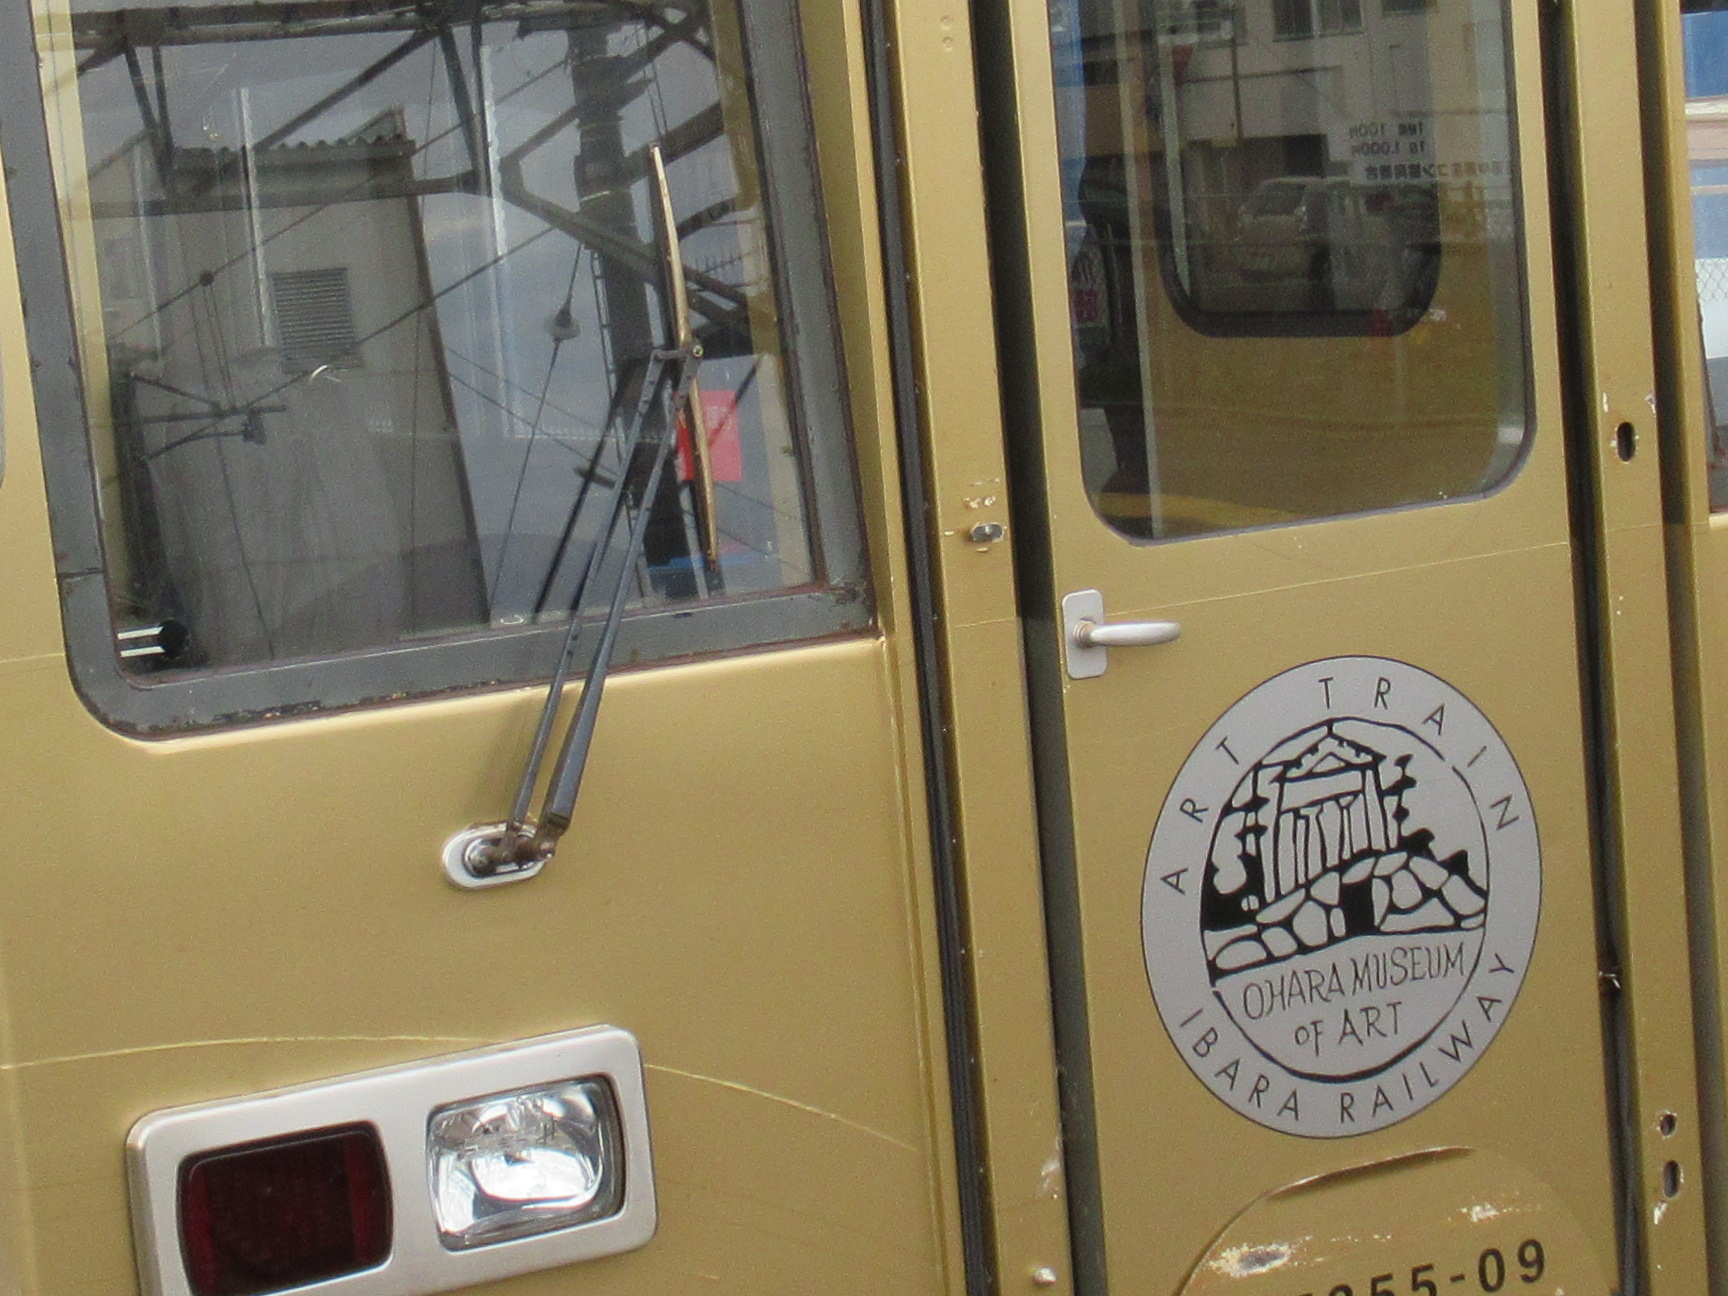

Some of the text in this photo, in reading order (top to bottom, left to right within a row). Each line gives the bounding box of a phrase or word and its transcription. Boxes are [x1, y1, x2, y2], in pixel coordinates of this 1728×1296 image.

[1160, 676, 1520, 895] ART TRAIN
[1178, 952, 1515, 1124] IBARA RAILWAY
[1242, 941, 1466, 1021] OHARA MUSEUM
[1337, 1001, 1403, 1046] ART
